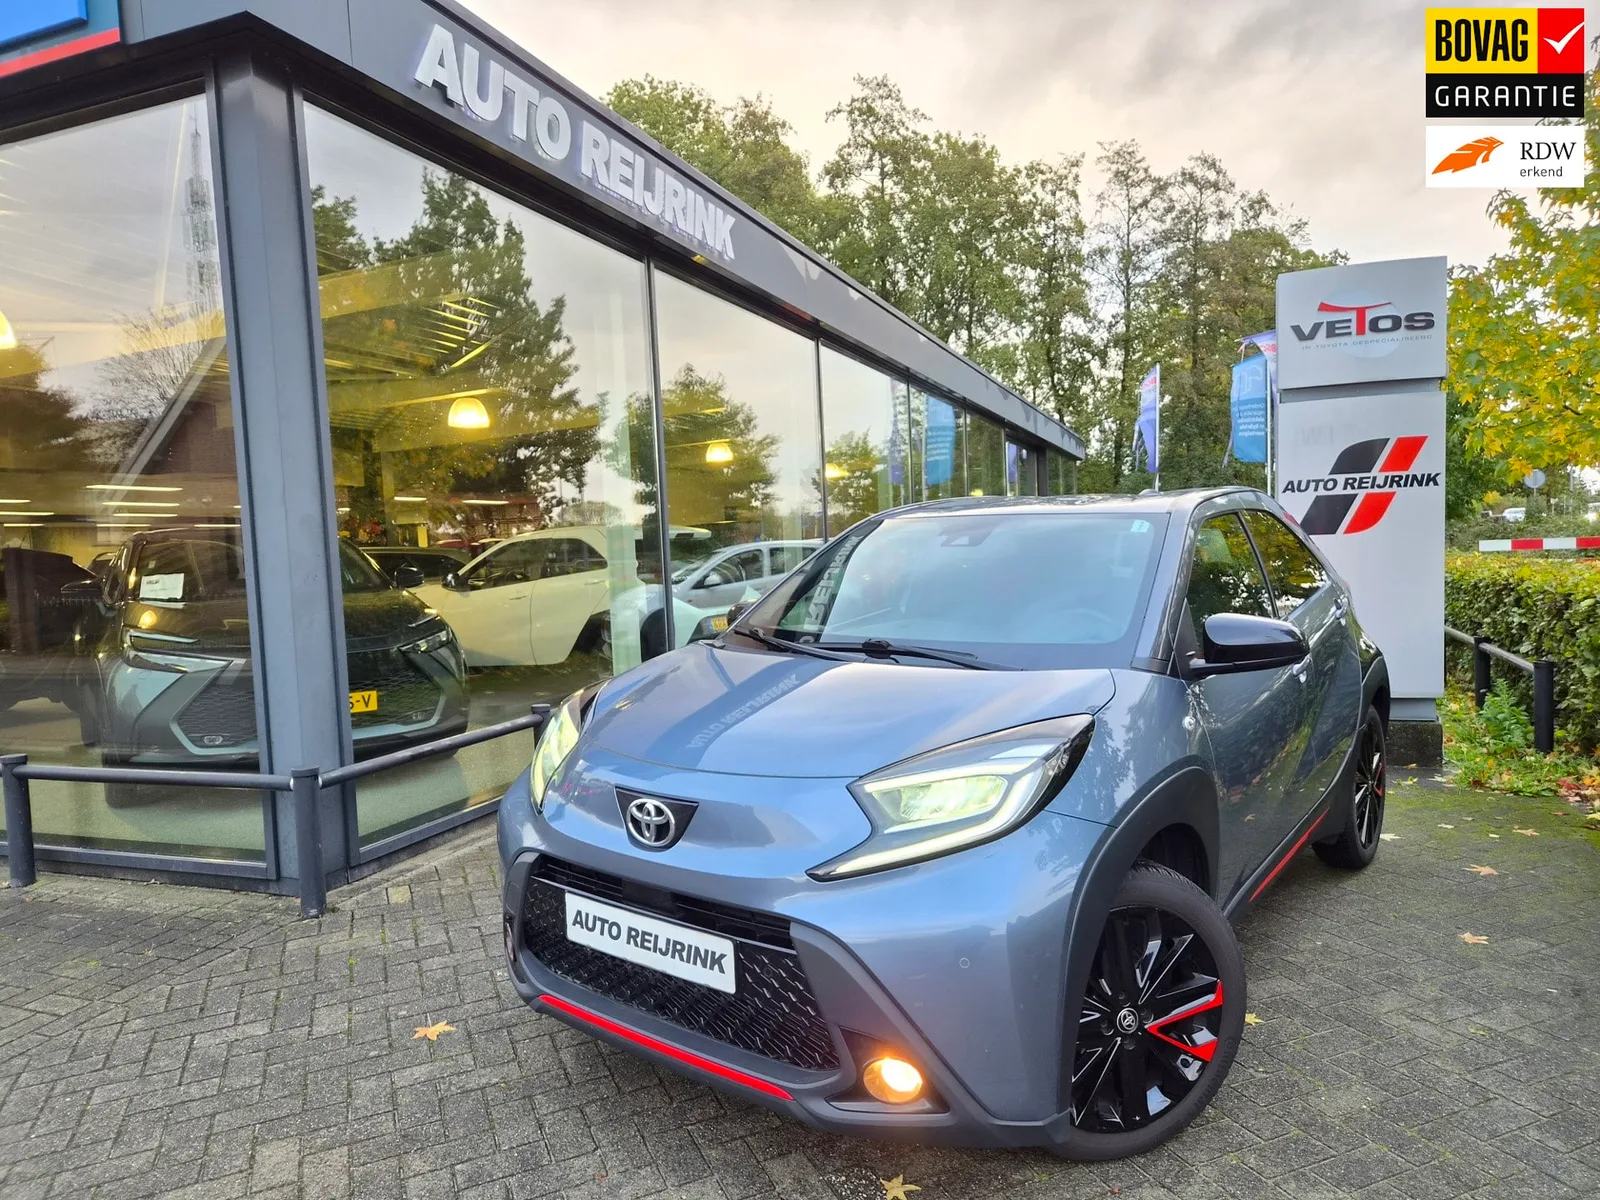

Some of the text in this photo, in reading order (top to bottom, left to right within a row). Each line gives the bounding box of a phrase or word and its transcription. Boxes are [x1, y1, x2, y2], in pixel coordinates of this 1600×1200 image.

[413, 24, 736, 260] AUTO REIJRINK
[1290, 301, 1435, 341] VETOS
[1282, 473, 1441, 494] AUTO REIJRINK
[572, 910, 727, 974] AUTO REIJRINK
